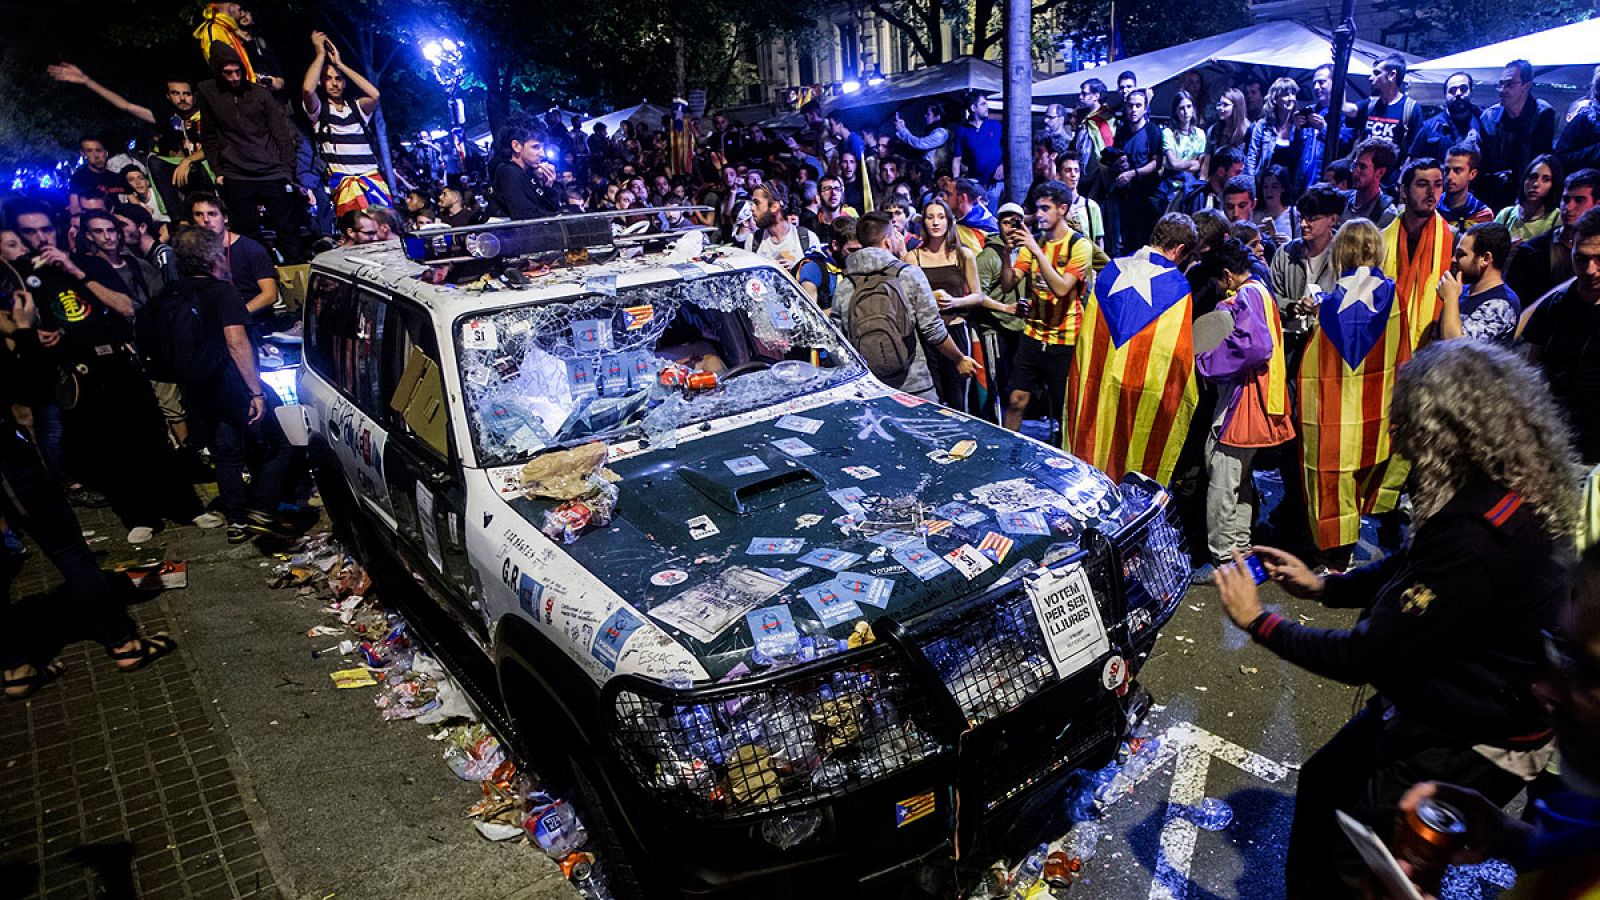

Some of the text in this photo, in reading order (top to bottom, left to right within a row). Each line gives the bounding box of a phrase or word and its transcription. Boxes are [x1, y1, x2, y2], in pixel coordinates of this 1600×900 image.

[1043, 582, 1081, 607] VOTEM
[1044, 594, 1088, 624] PER SER
[1049, 607, 1091, 636] LLIURES
[638, 650, 674, 666] ESCAC
